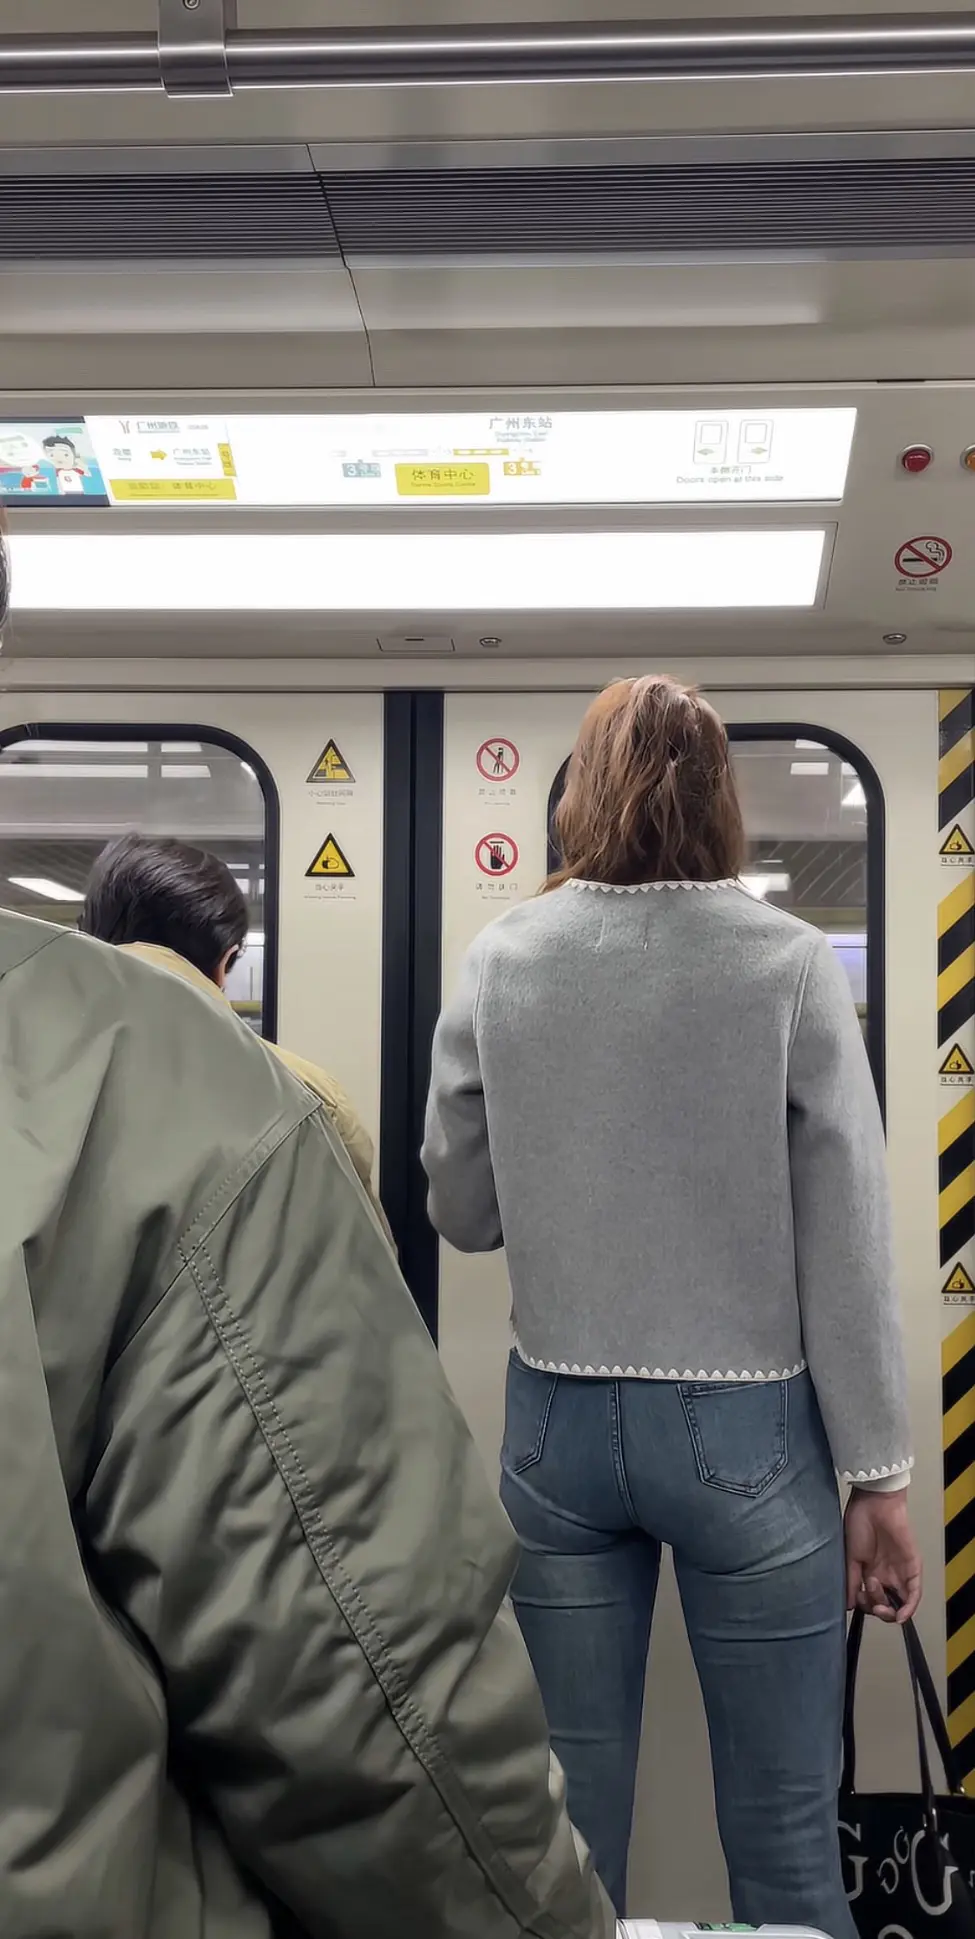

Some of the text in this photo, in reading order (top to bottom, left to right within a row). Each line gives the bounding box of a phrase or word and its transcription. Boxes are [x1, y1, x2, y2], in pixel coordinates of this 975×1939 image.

[489, 416, 552, 429] 广州东站
[411, 468, 475, 481] 体育中心
[708, 476, 731, 484] open
